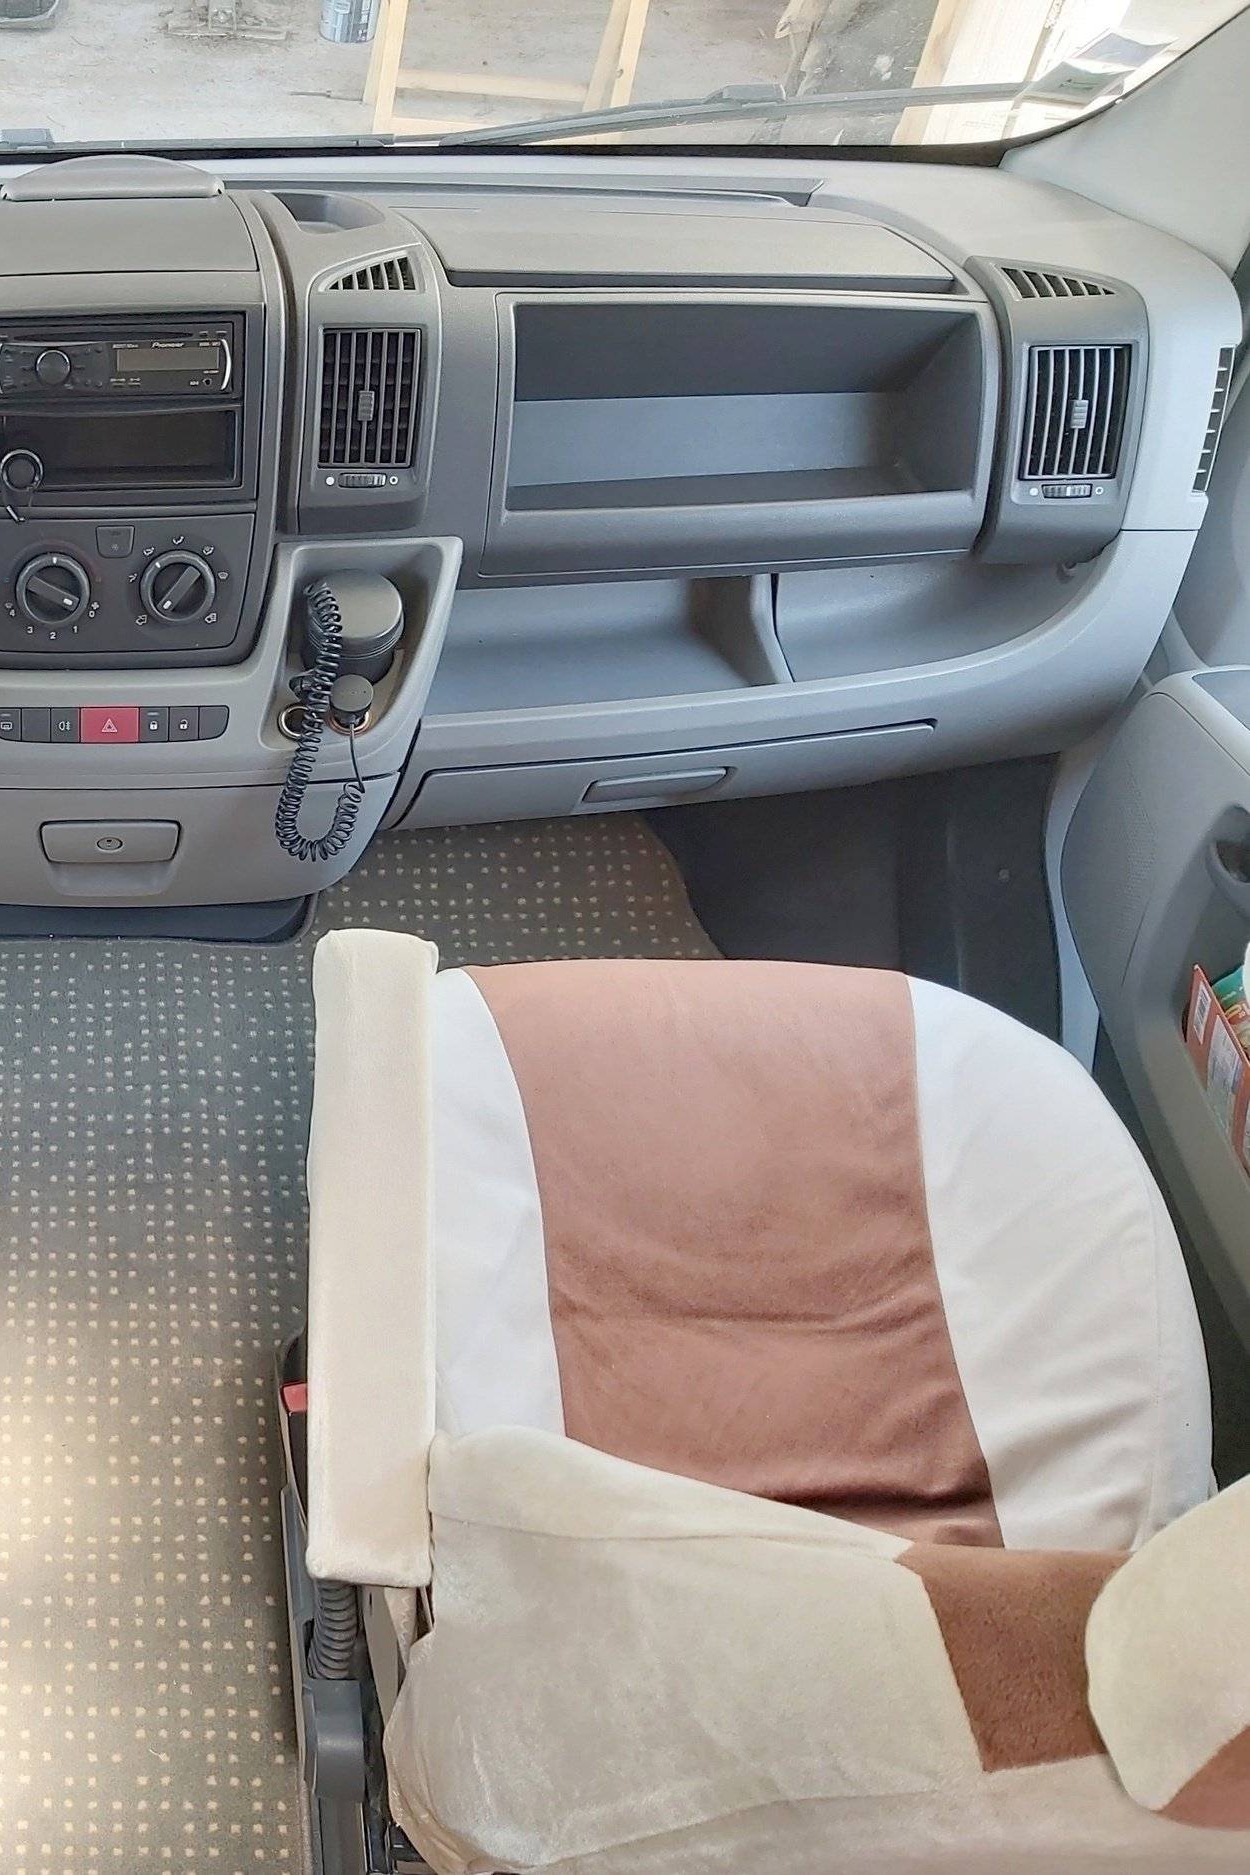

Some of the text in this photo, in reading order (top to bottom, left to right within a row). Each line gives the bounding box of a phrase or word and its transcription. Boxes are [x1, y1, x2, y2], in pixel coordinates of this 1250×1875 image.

[9, 609, 16, 617] 4
[88, 610, 96, 618] 0
[27, 626, 34, 634] 3
[72, 625, 79, 633] 1
[49, 631, 57, 640] 2
